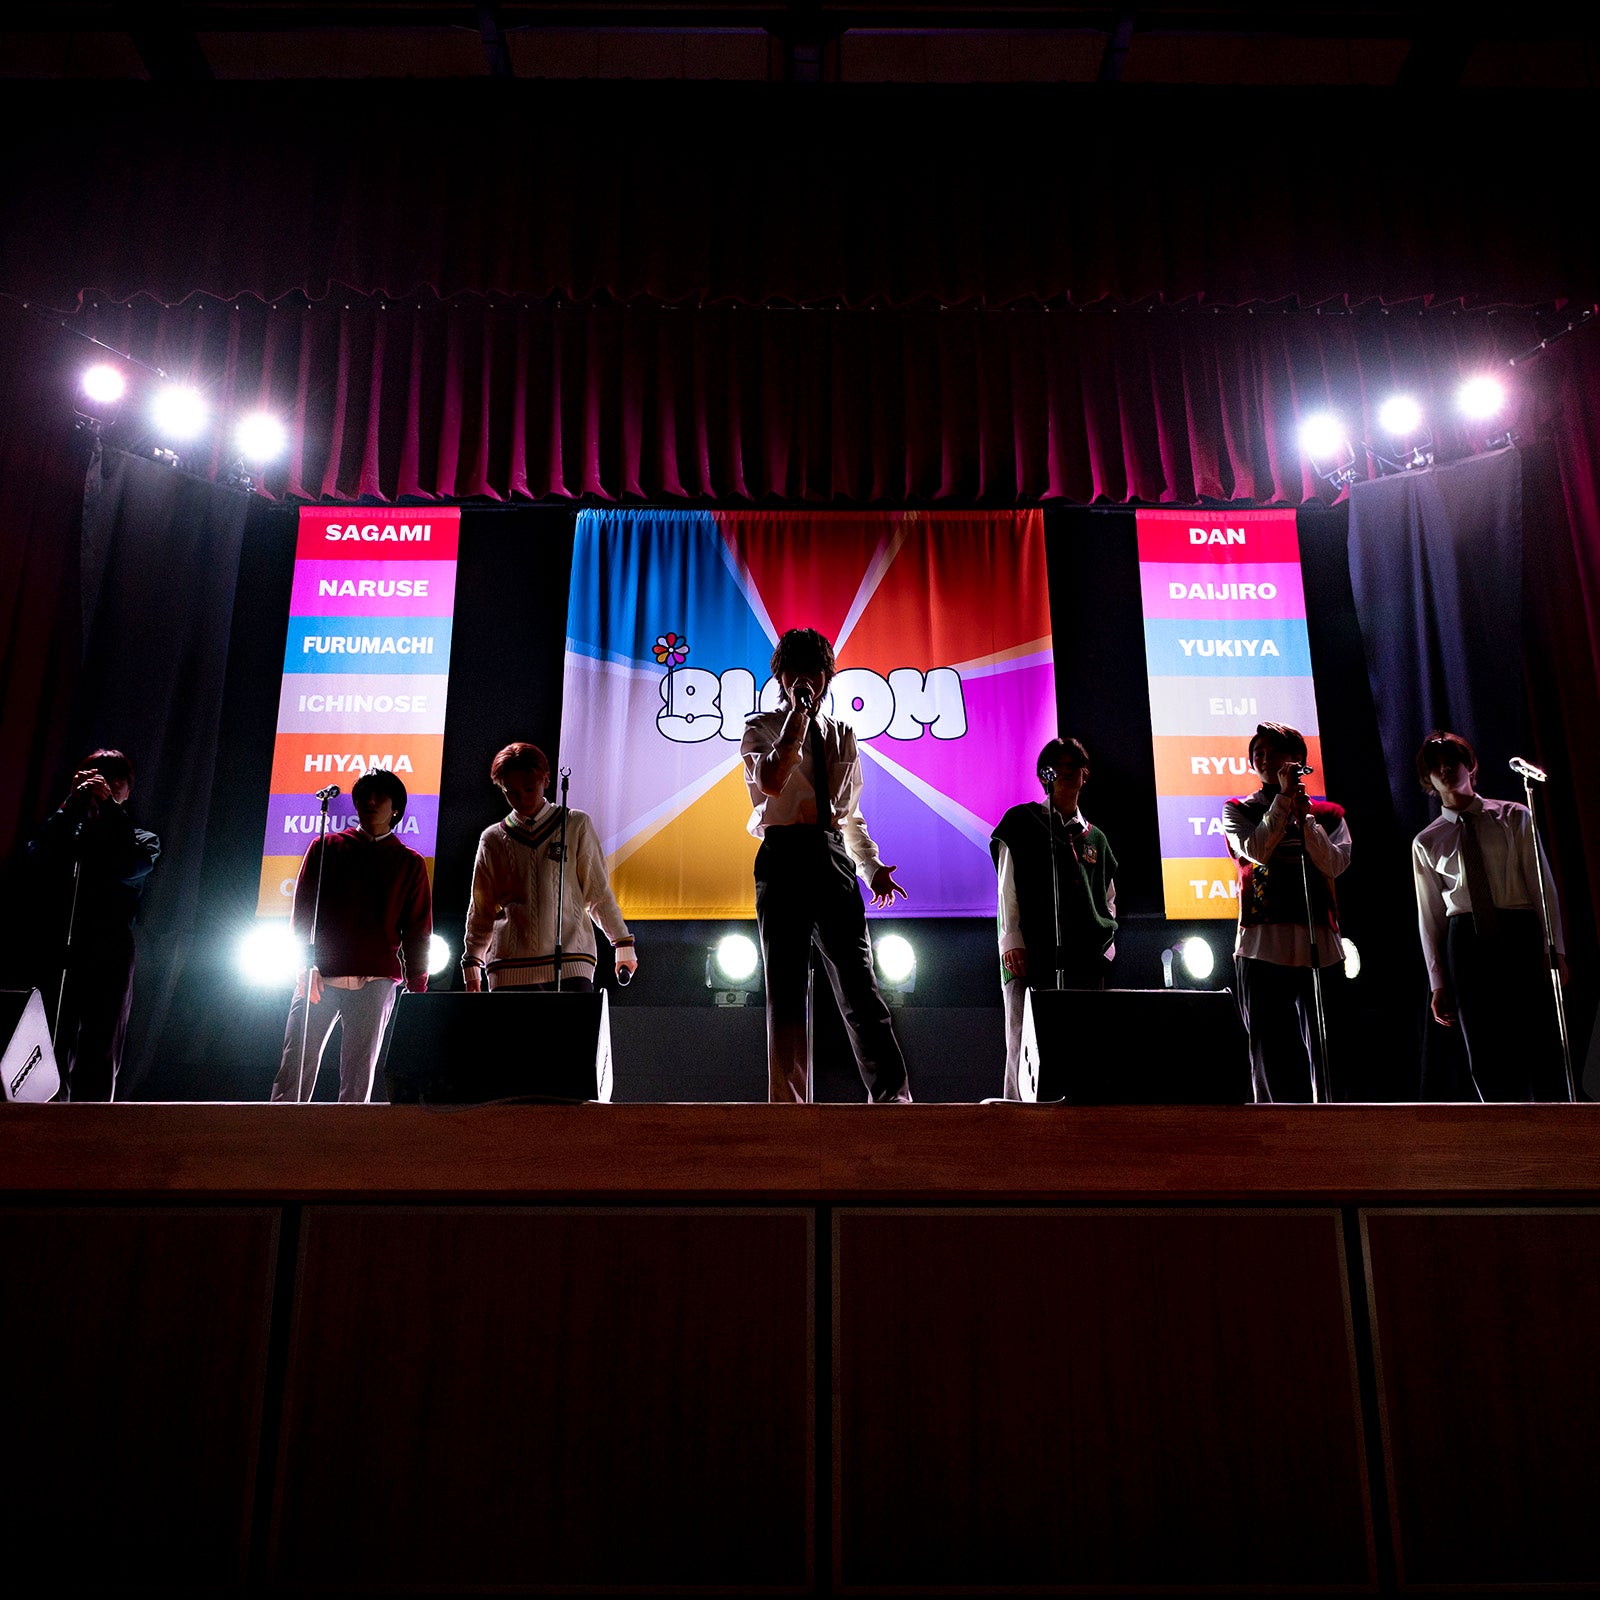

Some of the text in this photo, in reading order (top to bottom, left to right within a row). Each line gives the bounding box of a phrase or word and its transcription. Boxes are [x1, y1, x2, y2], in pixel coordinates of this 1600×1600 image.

[325, 524, 431, 542] SAGAMI
[1188, 527, 1246, 546] DAN
[318, 579, 429, 598] NARUSE
[1168, 582, 1278, 601] DAIJIRO
[302, 635, 434, 655] FURUMACHI
[1178, 638, 1280, 658] YUKIYA
[298, 694, 427, 713] ICHINOSE
[1209, 697, 1258, 717] EIJI
[303, 754, 414, 773] HIYAMA
